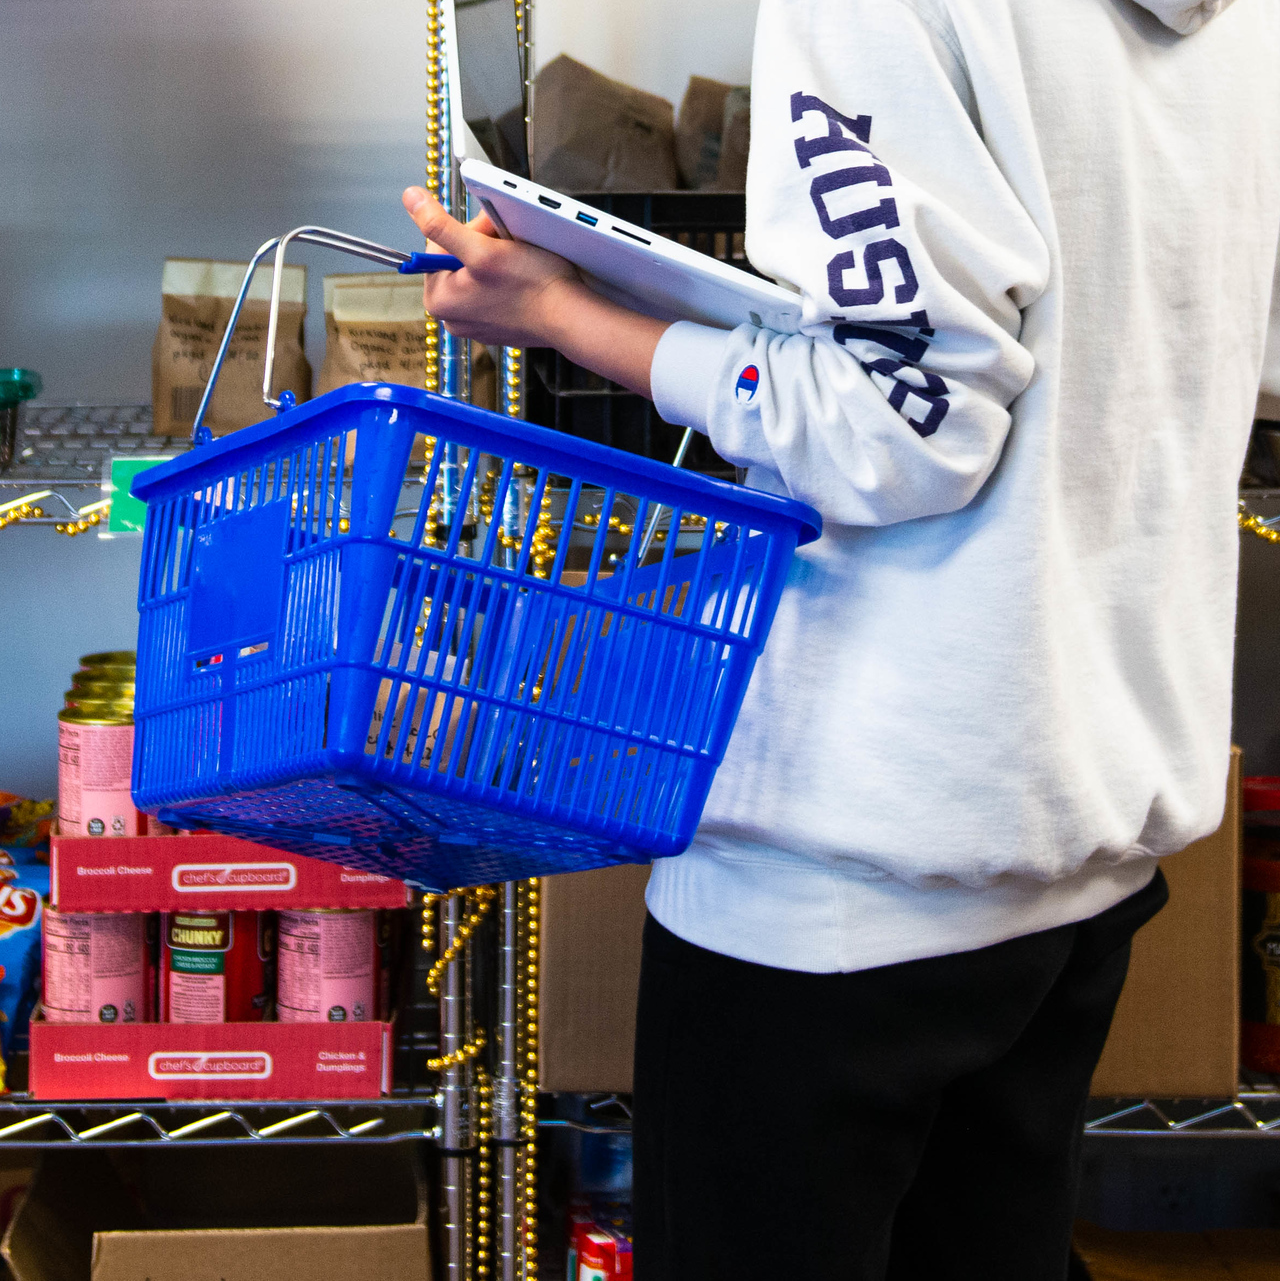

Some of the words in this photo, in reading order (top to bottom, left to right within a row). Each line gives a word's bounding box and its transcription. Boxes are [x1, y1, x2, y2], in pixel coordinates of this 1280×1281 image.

[77, 865, 115, 876] Broccoli
[117, 865, 153, 876] Cheese
[183, 872, 217, 885] chef's
[340, 872, 391, 885] Dumplings
[171, 929, 223, 947] CHUNKY
[54, 1051, 92, 1063] Broccoli
[94, 1051, 129, 1063] Cheese
[159, 1059, 192, 1072] chef's
[317, 1051, 353, 1062] Chicken
[358, 1051, 366, 1062] &
[316, 1062, 365, 1074] Dumplings
